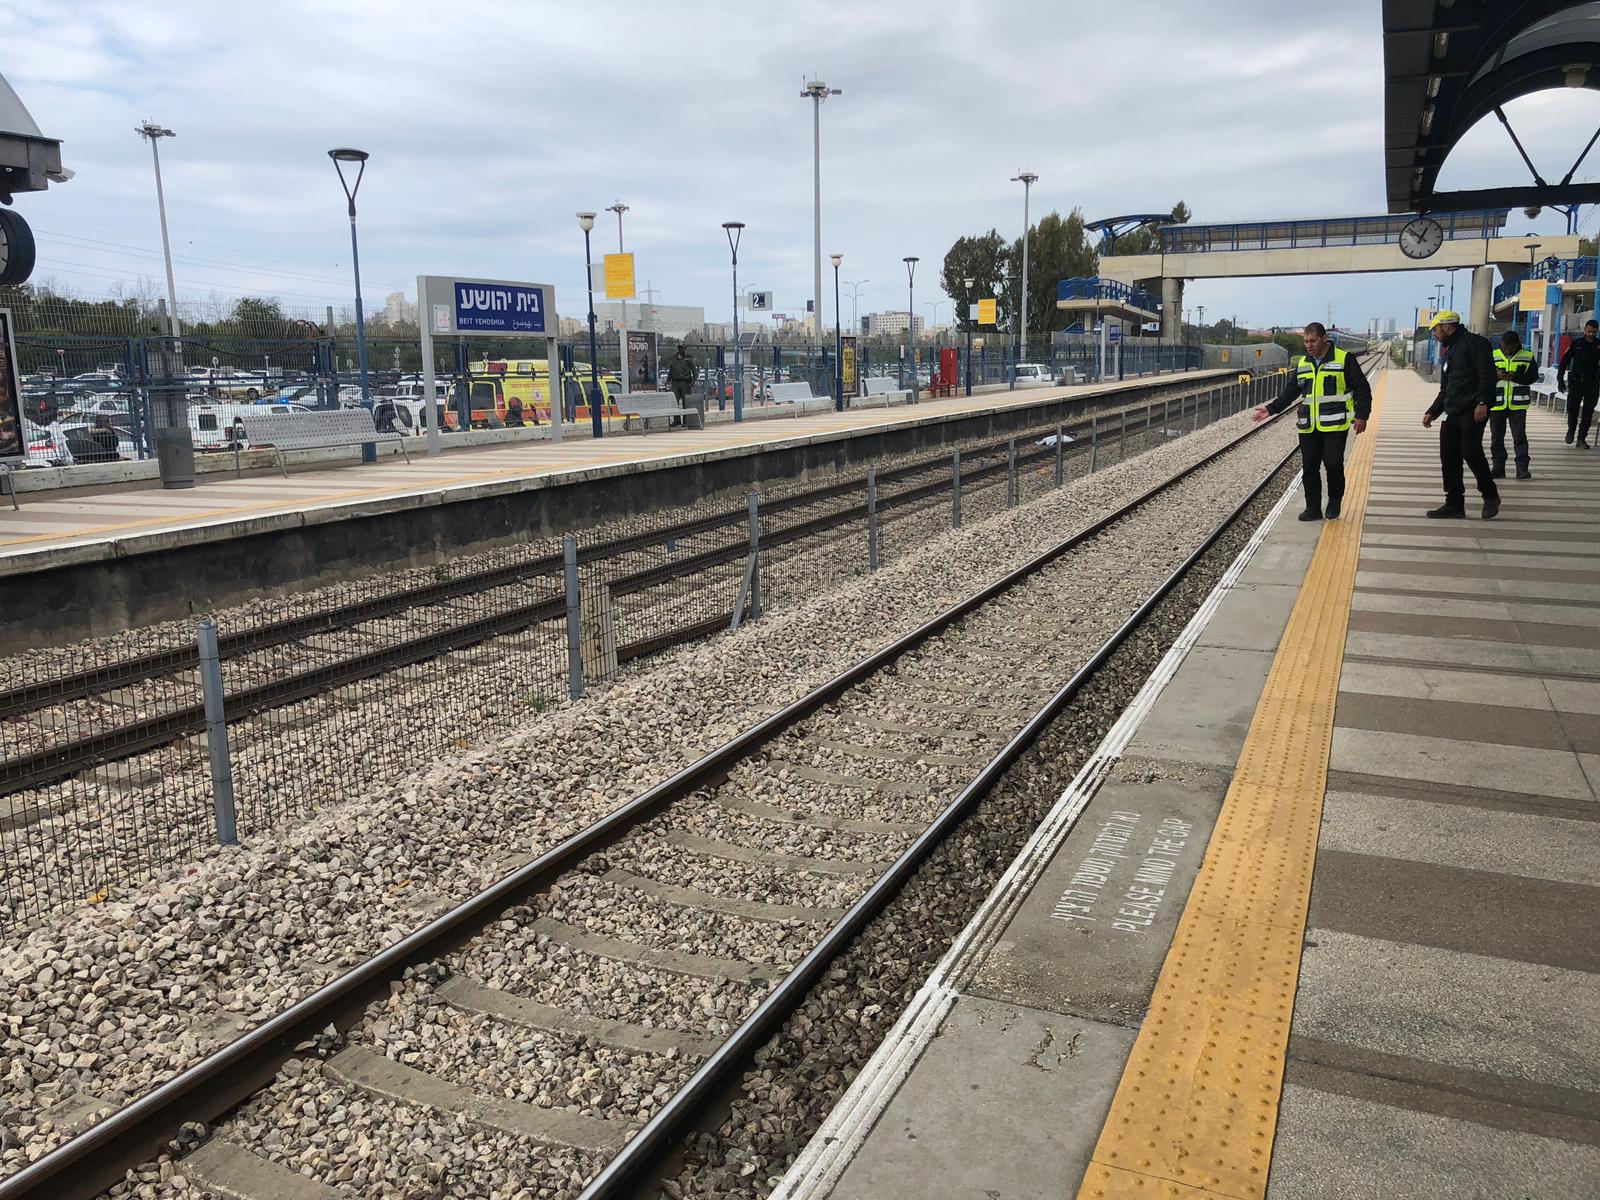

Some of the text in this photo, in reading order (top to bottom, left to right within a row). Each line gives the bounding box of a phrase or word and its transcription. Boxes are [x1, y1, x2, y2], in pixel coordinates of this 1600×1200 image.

[460, 288, 540, 313] בית יהושע
[753, 294, 760, 307] 2
[459, 317, 506, 326] BEIT YEHOSHUA
[1240, 376, 1247, 384] א
[1050, 810, 1141, 921] נא להתרחק משפת הרציף
[1111, 818, 1193, 934] PLEASE MIND THE GAP
